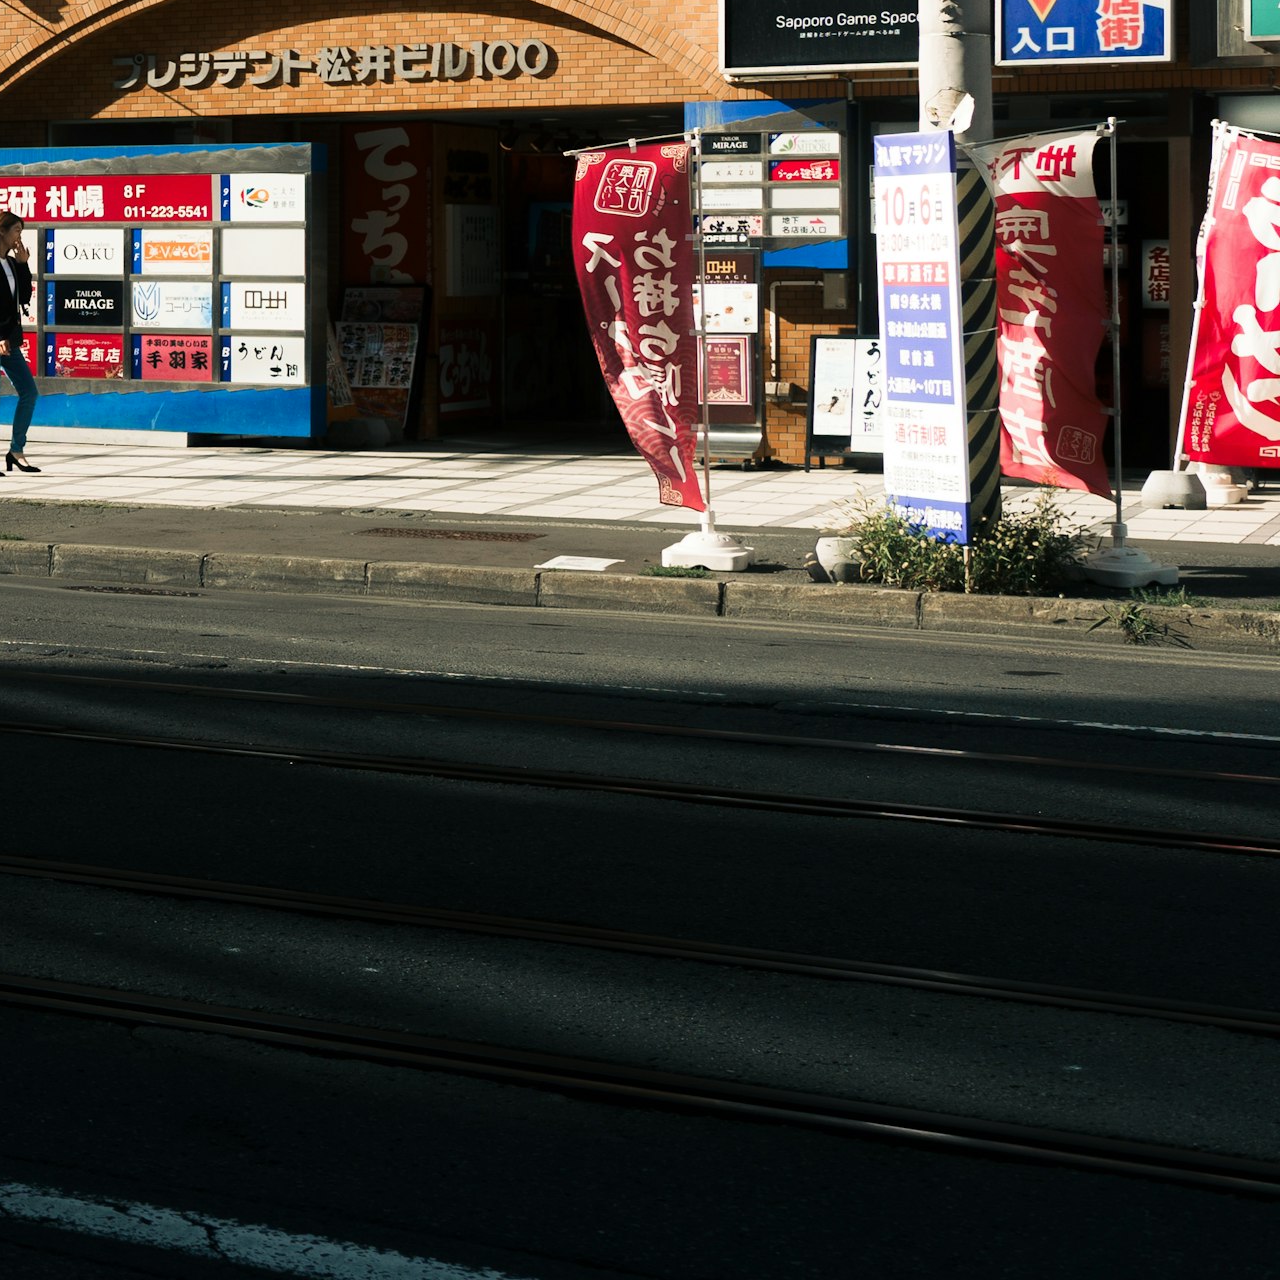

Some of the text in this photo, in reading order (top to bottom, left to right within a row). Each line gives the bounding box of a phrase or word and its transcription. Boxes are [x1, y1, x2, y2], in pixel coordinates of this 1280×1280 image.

[776, 9, 919, 30] Sapporo Game Spac
[1011, 26, 1075, 54] 入口
[113, 38, 551, 90] プレジデント松井ビル100
[712, 141, 749, 150] MIRAGE
[876, 142, 947, 169] 札幌マラソン
[123, 184, 147, 199] 8F
[45, 185, 105, 218] 札幌
[123, 205, 209, 219] 011-223-5541
[782, 216, 799, 225] 地下
[782, 226, 827, 234] 名店街入口
[63, 243, 115, 261] OAKU
[884, 263, 947, 283] 車両通行止
[1147, 245, 1171, 302] 名店街
[76, 290, 102, 298] TAILOR
[64, 298, 115, 310] MIRAGE
[165, 302, 211, 314] ユーリード
[146, 339, 208, 349] 手羽の美味しい店
[237, 342, 285, 362] うどん
[57, 346, 121, 363] 奥芝商店
[146, 349, 209, 370] 手羽家
[438, 331, 493, 398] てっちゃん
[894, 423, 948, 447] 通行制限
